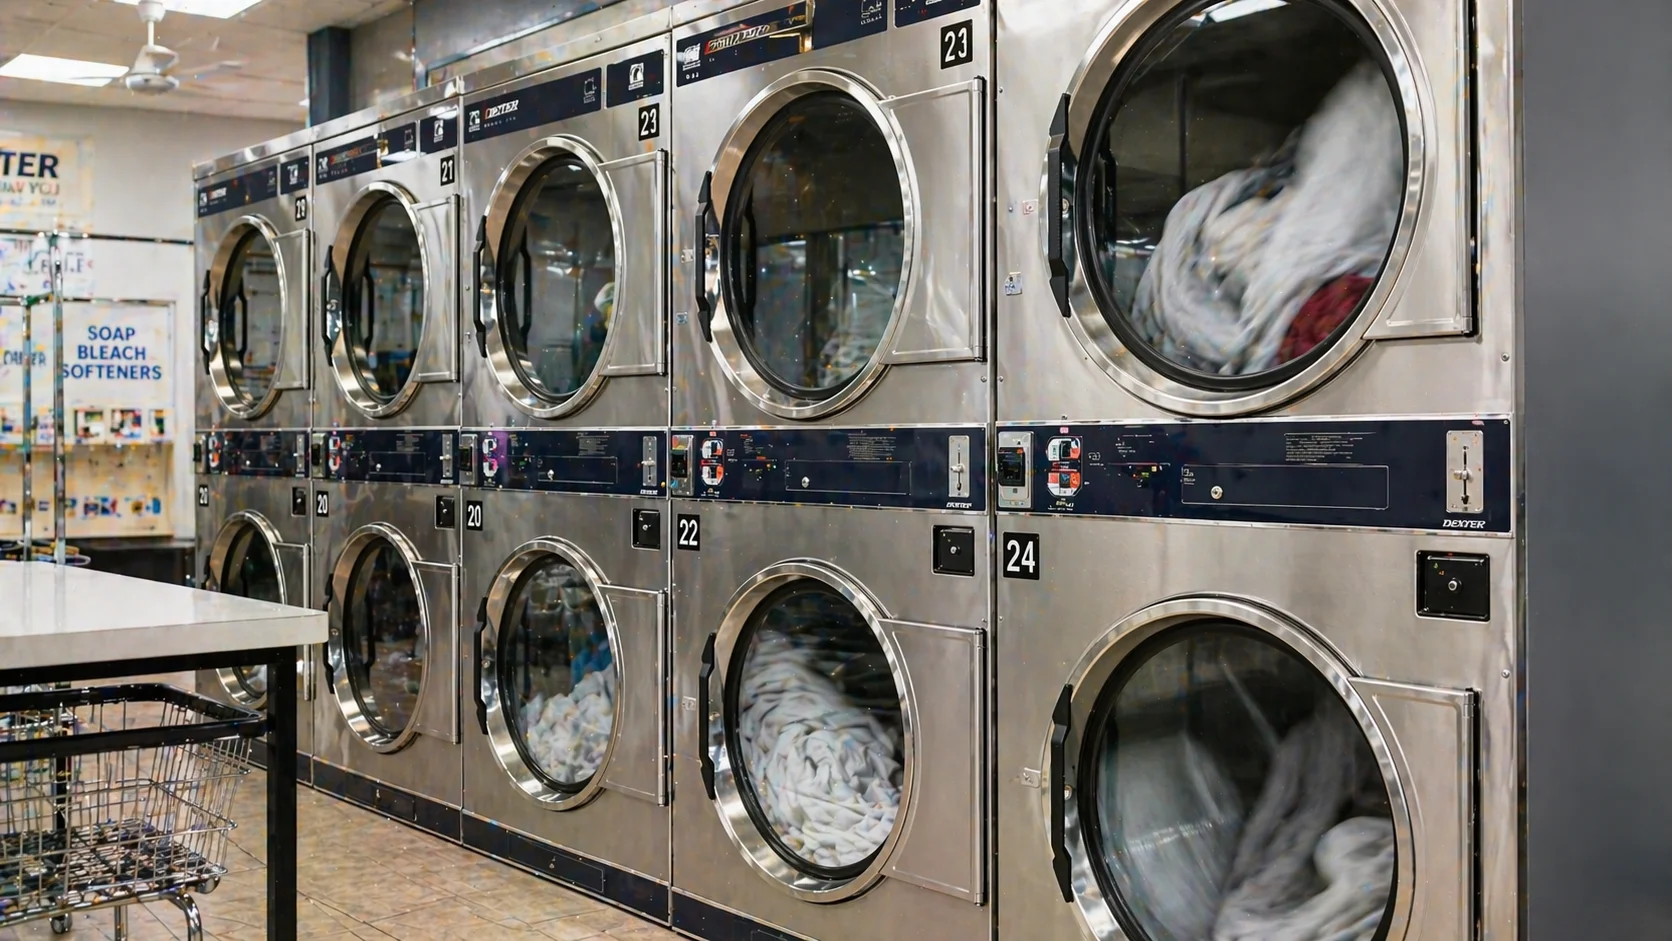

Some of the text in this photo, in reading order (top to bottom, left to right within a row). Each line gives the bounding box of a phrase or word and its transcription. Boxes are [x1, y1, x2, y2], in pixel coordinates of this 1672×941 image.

[944, 27, 968, 63] 23
[640, 108, 658, 136] 23
[0, 149, 59, 179] TER
[441, 159, 454, 183] 21
[88, 325, 136, 341] SOAP
[77, 345, 147, 361] BLEACH
[63, 364, 162, 380] SOFTENERS
[317, 494, 328, 514] 20
[467, 504, 482, 527] 20
[679, 519, 698, 546] 22
[1442, 519, 1486, 529] DEXTER
[1006, 539, 1036, 574] 24
